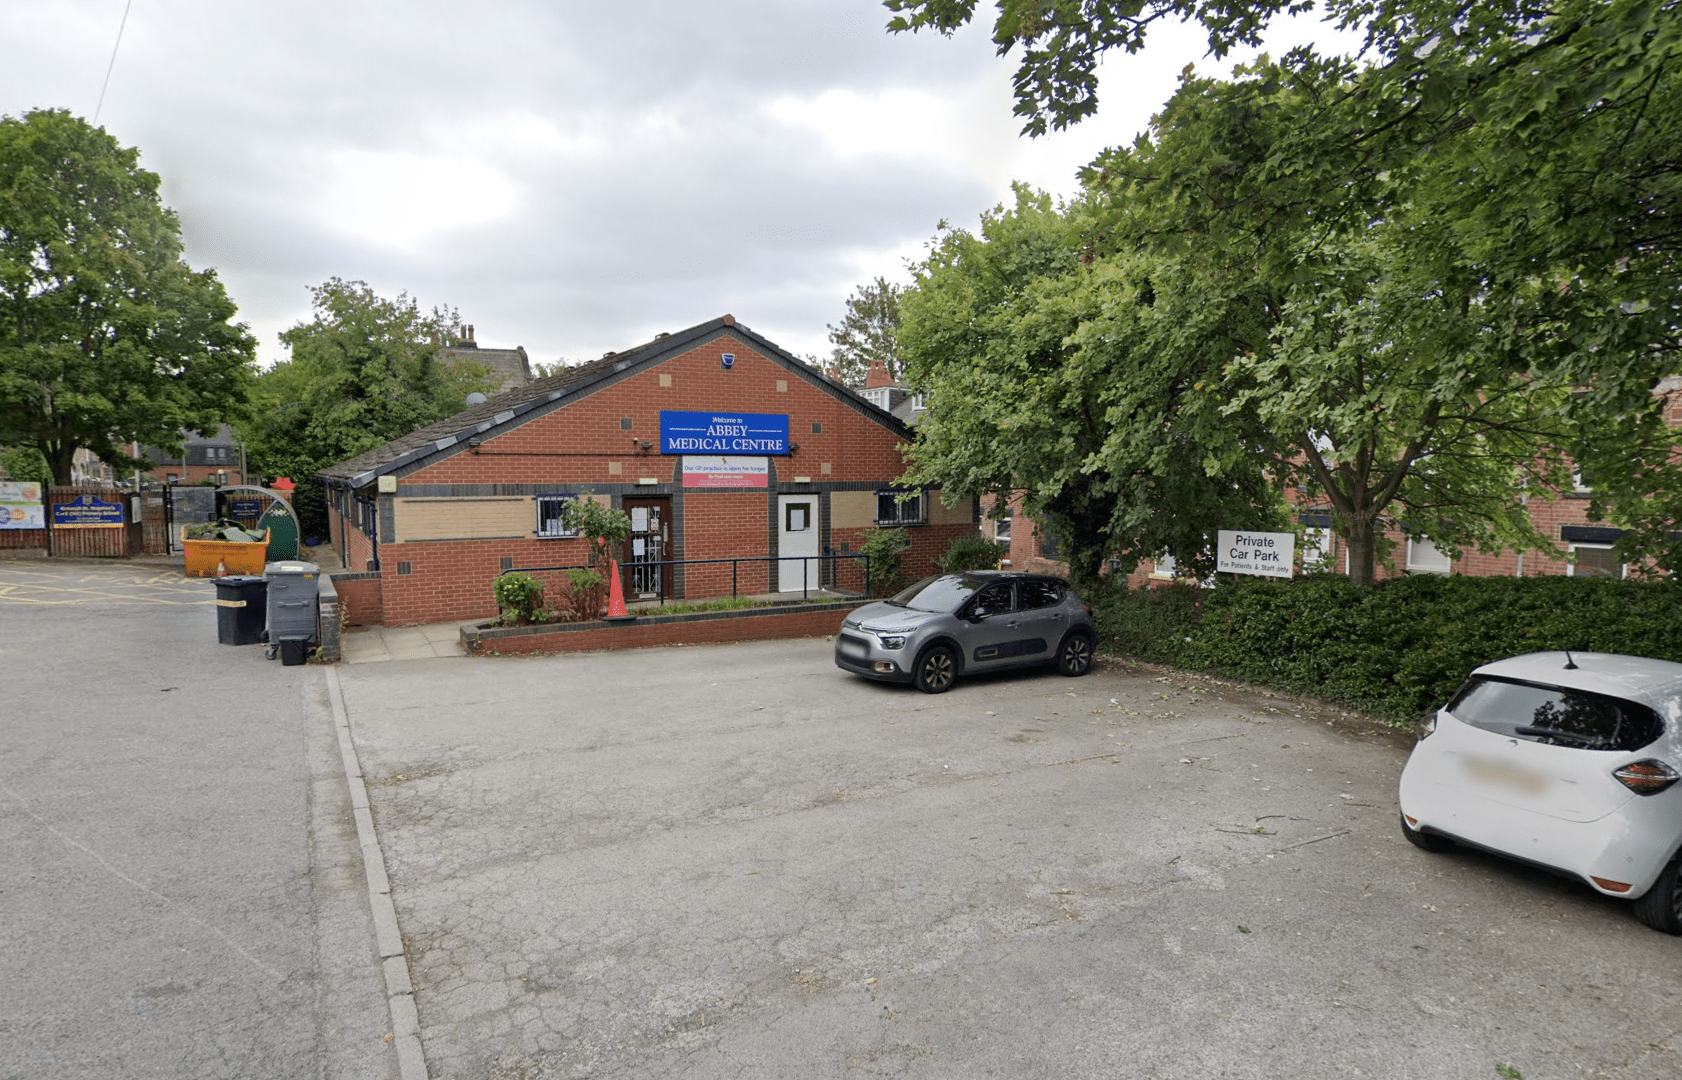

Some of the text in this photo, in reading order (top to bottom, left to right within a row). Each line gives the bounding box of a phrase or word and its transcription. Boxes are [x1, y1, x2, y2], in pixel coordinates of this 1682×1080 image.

[706, 425, 748, 437] ABBEY
[668, 438, 783, 451] MEDICAL CENTRE
[1235, 535, 1275, 548] Private
[1230, 548, 1279, 562] Car Park
[1231, 562, 1252, 570] Patients
